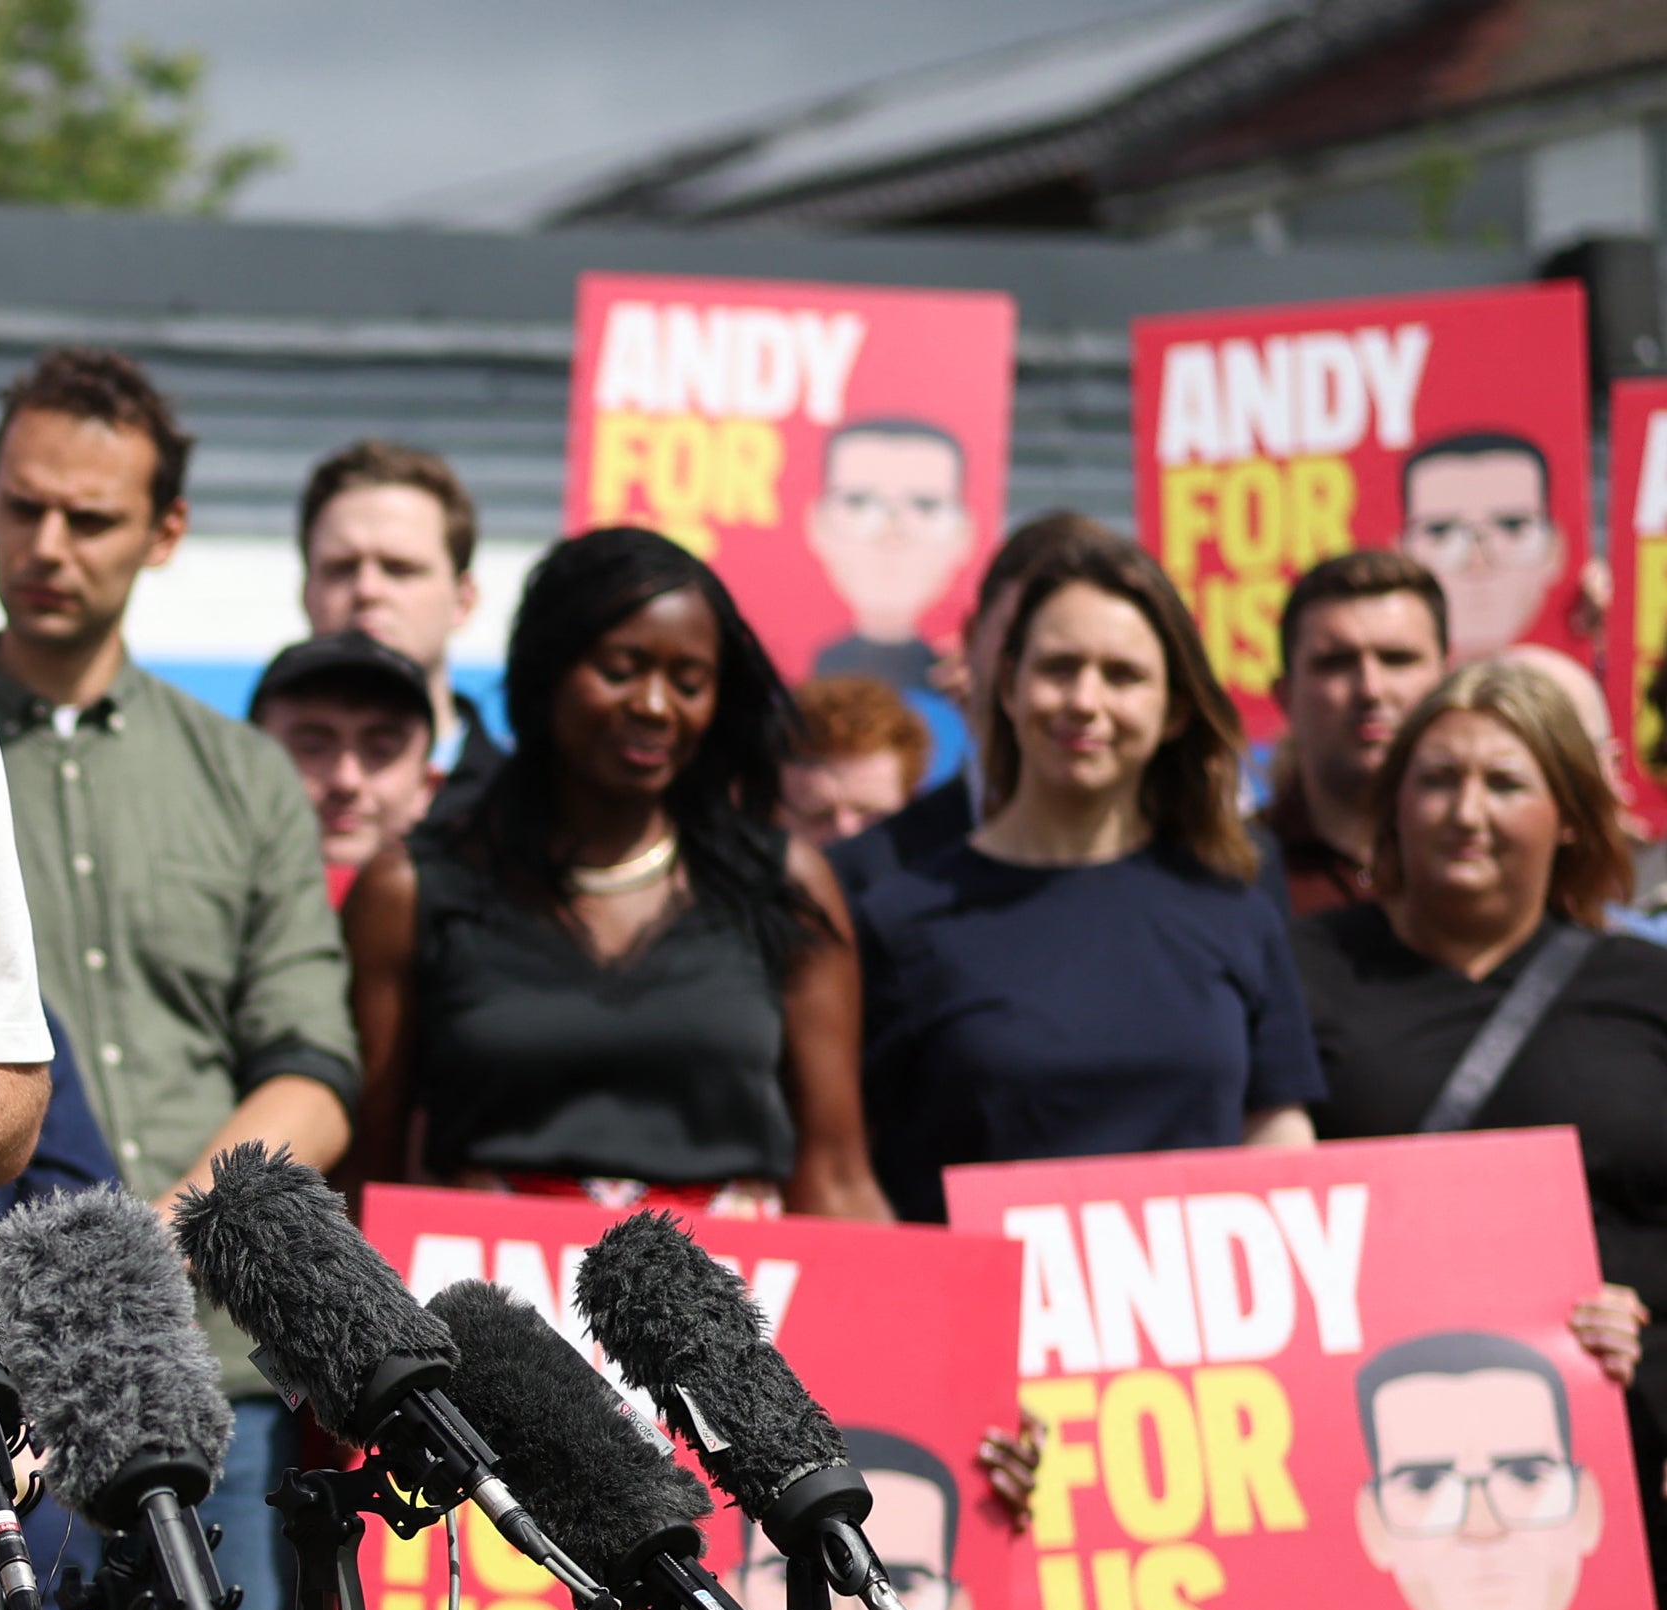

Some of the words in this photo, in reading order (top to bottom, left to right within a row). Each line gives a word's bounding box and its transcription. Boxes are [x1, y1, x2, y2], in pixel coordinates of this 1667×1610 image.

[595, 301, 865, 426] ANDY
[1157, 322, 1431, 466] ANDY
[592, 413, 782, 528] FOR
[1162, 454, 1356, 577] FOR
[1003, 1183, 1369, 1376] ANDY
[627, 1410, 655, 1440] Rycote
[1019, 1364, 1308, 1548] FOR
